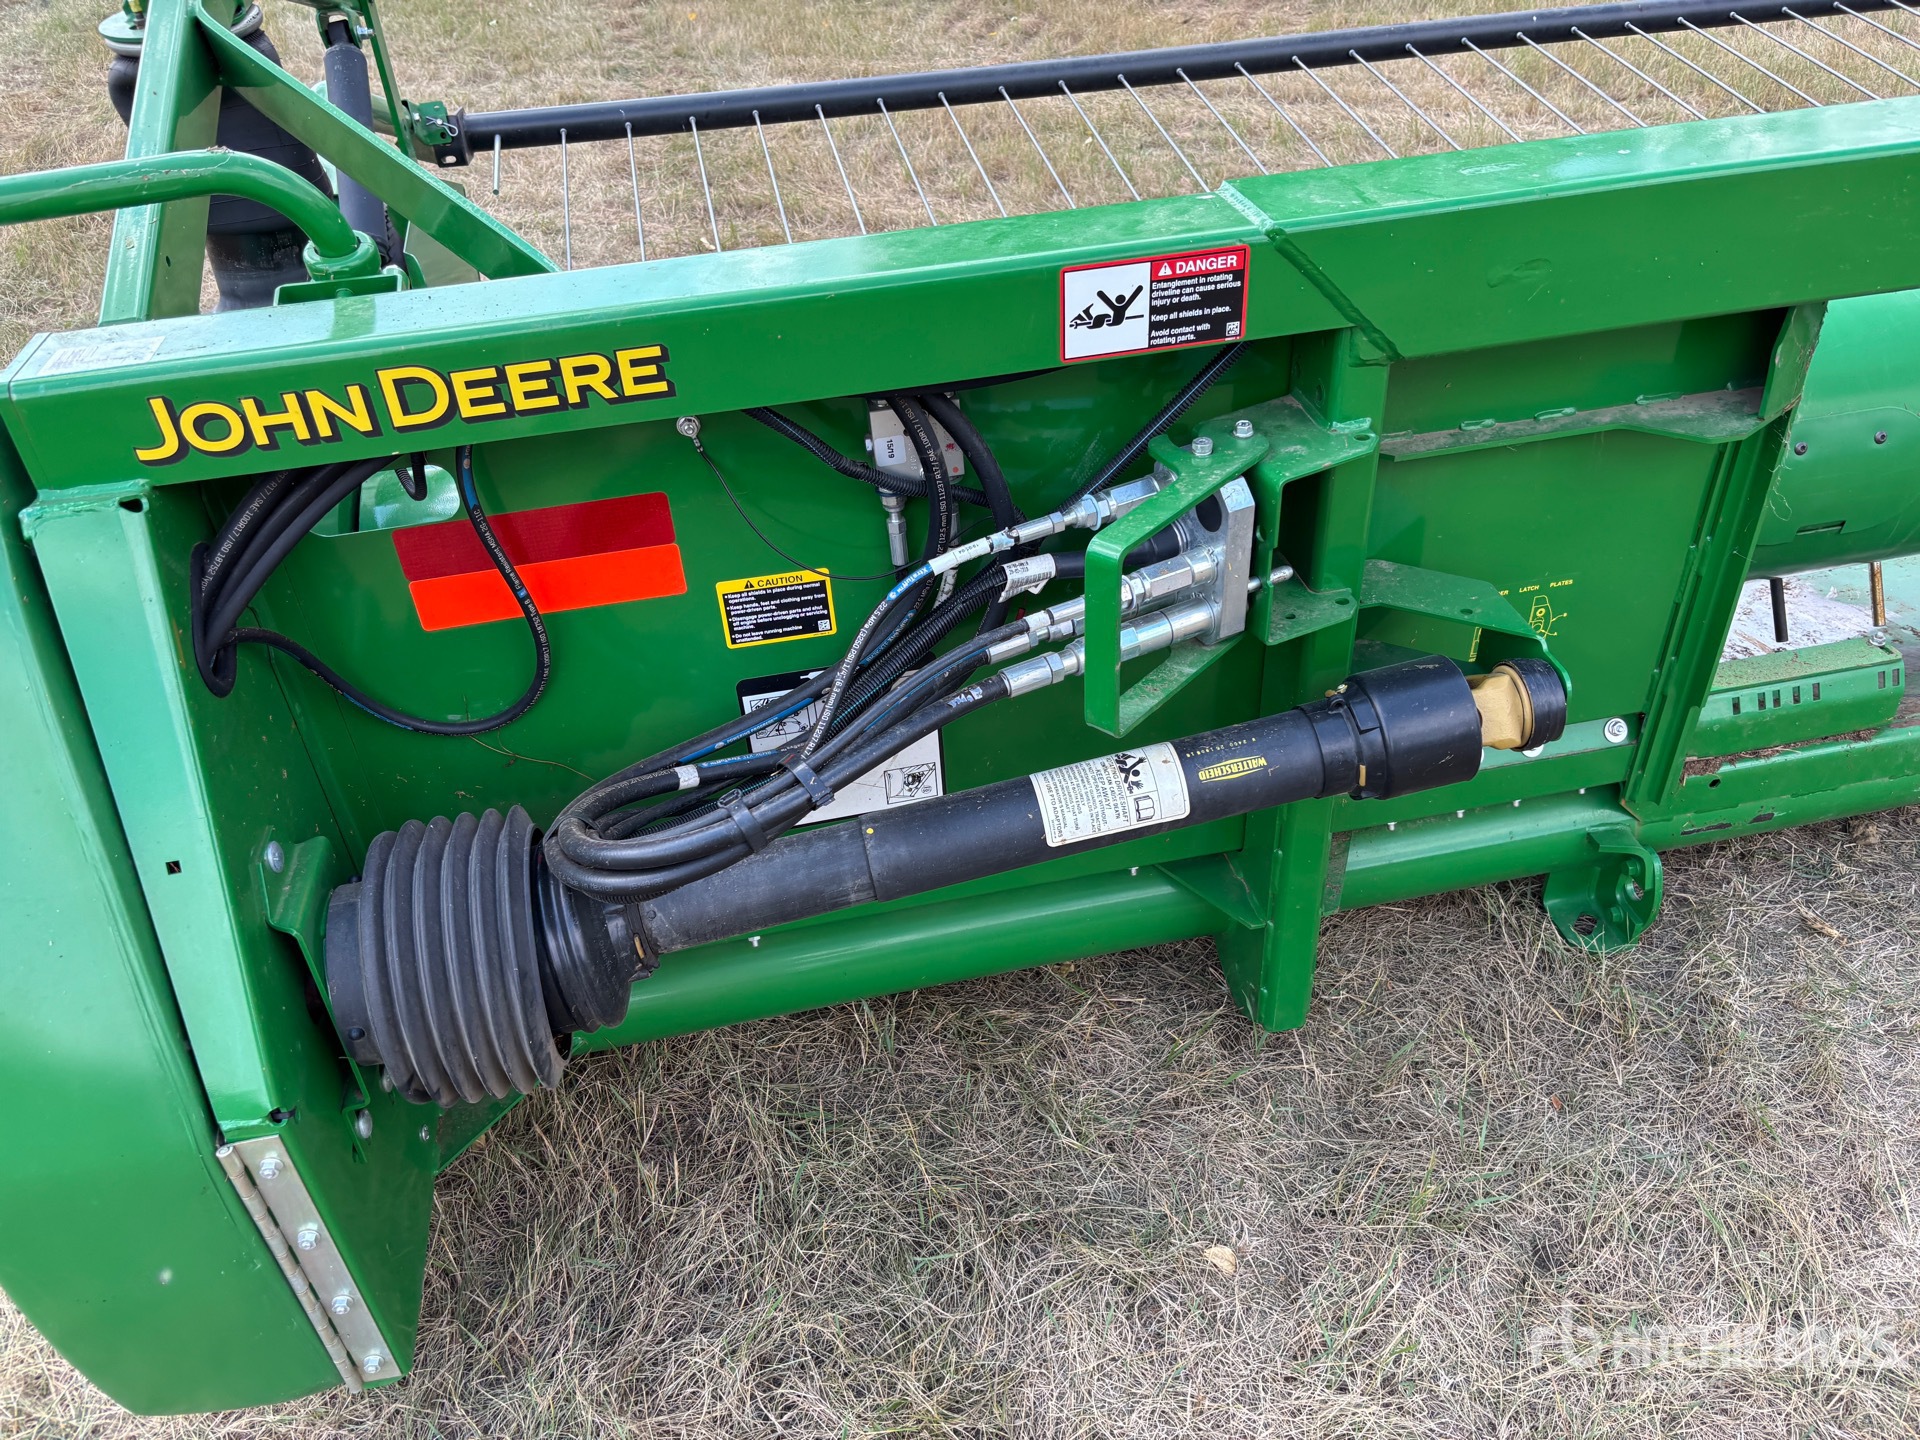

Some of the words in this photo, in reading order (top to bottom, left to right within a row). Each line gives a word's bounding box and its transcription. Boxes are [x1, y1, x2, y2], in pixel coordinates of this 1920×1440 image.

[1174, 254, 1238, 273] DANGER
[1150, 288, 1180, 297] driveline
[1216, 280, 1241, 288] serious
[1151, 278, 1198, 289] Entanglement
[1206, 272, 1233, 283] rotating
[1150, 297, 1171, 306] injury
[1180, 293, 1201, 301] death.
[1150, 313, 1168, 322] Keep
[1168, 311, 1177, 319] all
[1178, 309, 1202, 317] shields
[1211, 305, 1231, 313] place.
[1170, 325, 1195, 333] contact
[1149, 336, 1175, 345] rotating
[135, 383, 381, 466] JOHN
[376, 344, 676, 432] DEERE
[913, 422, 932, 449] 100R17
[886, 439, 894, 458] 15/19
[927, 447, 936, 461] SAE
[933, 465, 942, 478] R17
[936, 479, 946, 499] 11237
[230, 509, 253, 537] 100R17
[219, 538, 234, 554] ISO
[483, 530, 498, 548] MSHA
[207, 552, 226, 576] 18752
[492, 545, 513, 574] Resistant
[507, 571, 523, 590] Flame
[757, 574, 803, 587] CAUTION
[786, 584, 802, 592] during
[1518, 584, 1539, 592] LATCH
[1549, 579, 1573, 587] PLATES
[872, 599, 888, 617] 22.5
[772, 613, 799, 621] unclogging
[862, 613, 878, 631] MPa
[810, 719, 826, 743] 11237
[801, 740, 816, 756] R17
[1196, 755, 1268, 780] WALTERSCHEID
